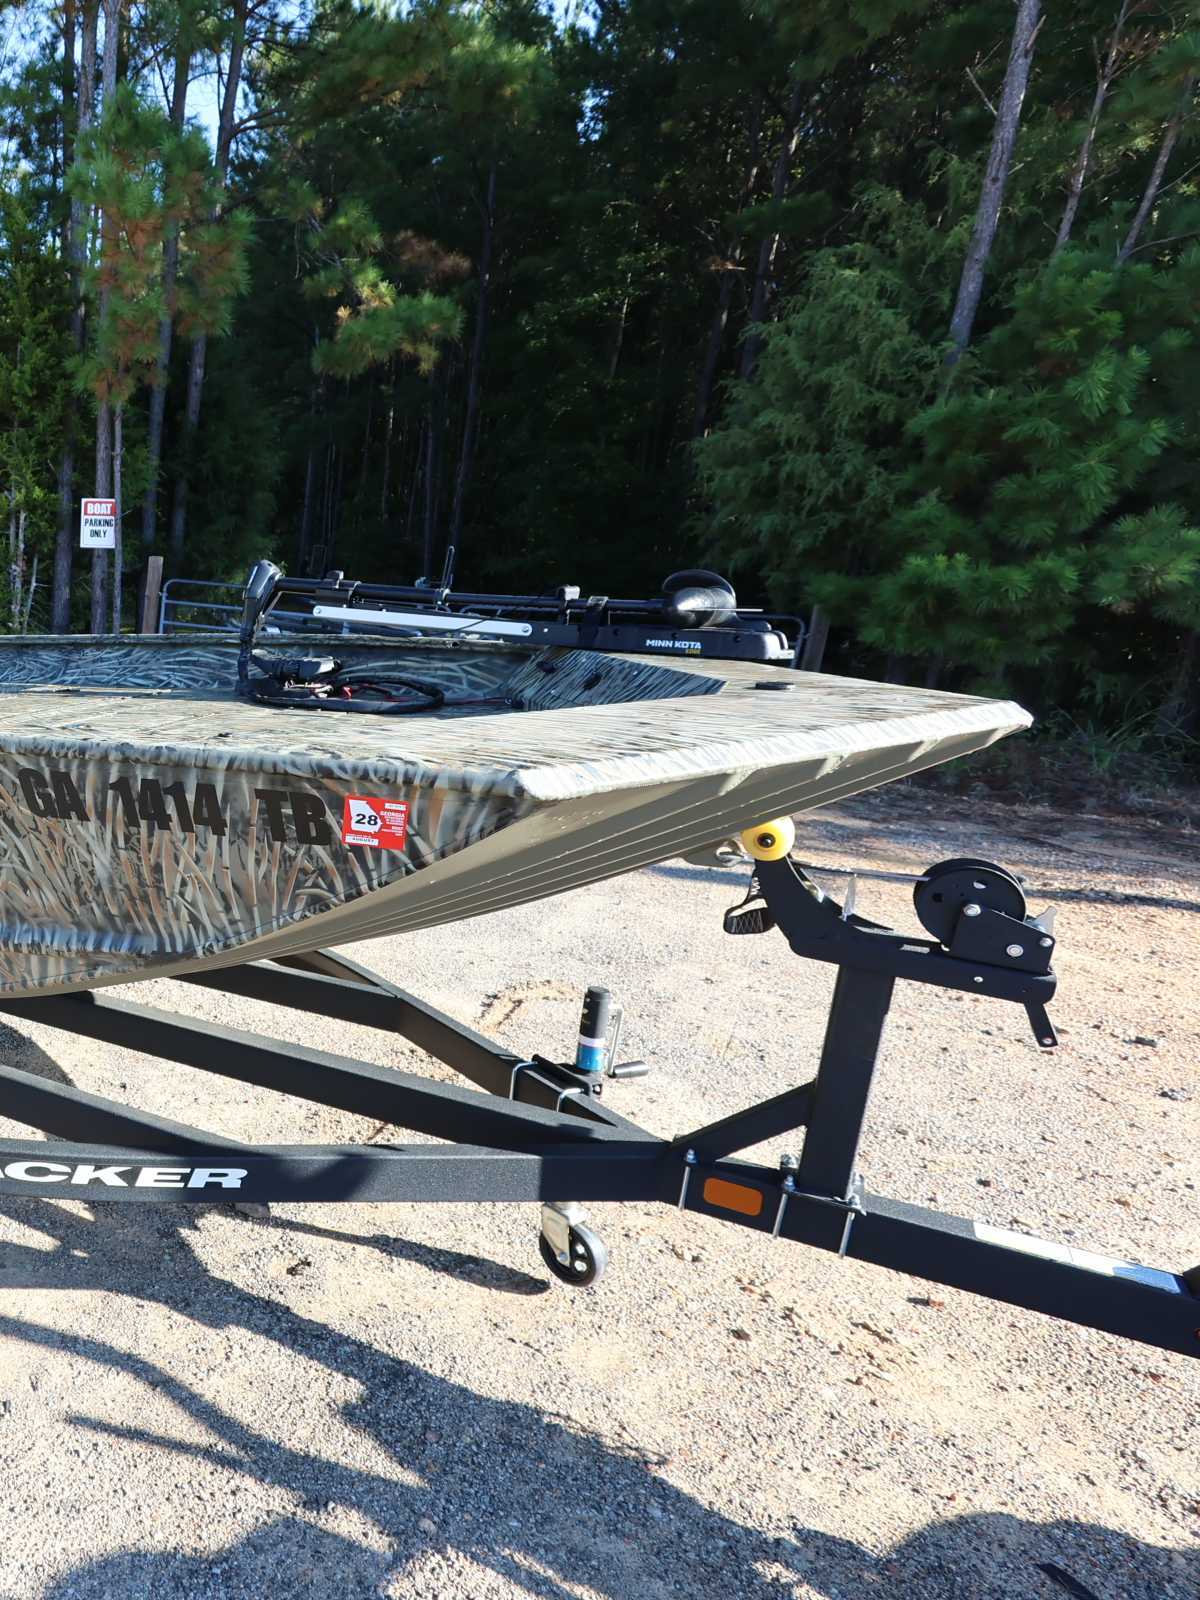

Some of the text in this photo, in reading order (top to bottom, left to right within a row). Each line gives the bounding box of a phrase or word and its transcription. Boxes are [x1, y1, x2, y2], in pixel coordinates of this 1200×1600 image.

[87, 503, 112, 514] BOAT
[84, 518, 114, 527] PARKING
[89, 529, 107, 538] ONLY
[645, 639, 702, 649] MINN KOTA
[17, 768, 330, 846] GA 1414 TB
[354, 813, 378, 826] 28
